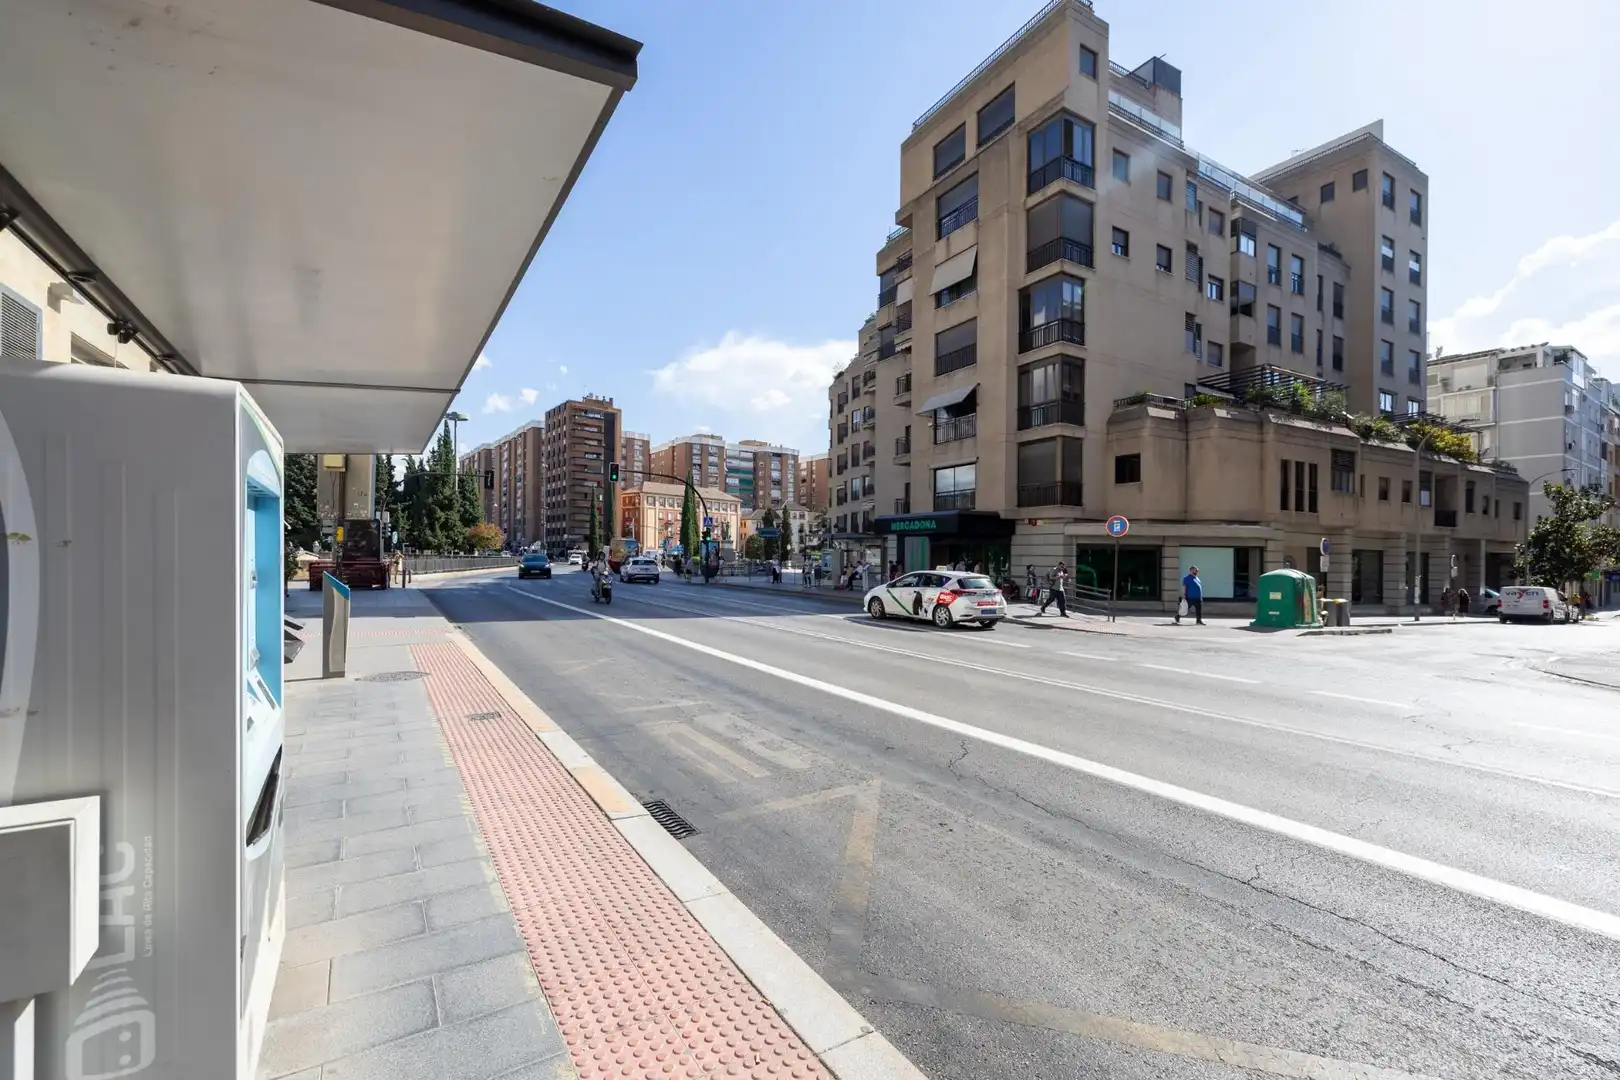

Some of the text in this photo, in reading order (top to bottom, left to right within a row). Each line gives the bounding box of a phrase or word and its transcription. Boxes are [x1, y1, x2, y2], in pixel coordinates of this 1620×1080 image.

[891, 520, 936, 530] MERCADONA
[143, 836, 154, 888] Capacidad
[143, 891, 153, 911] Alta
[143, 913, 153, 927] de
